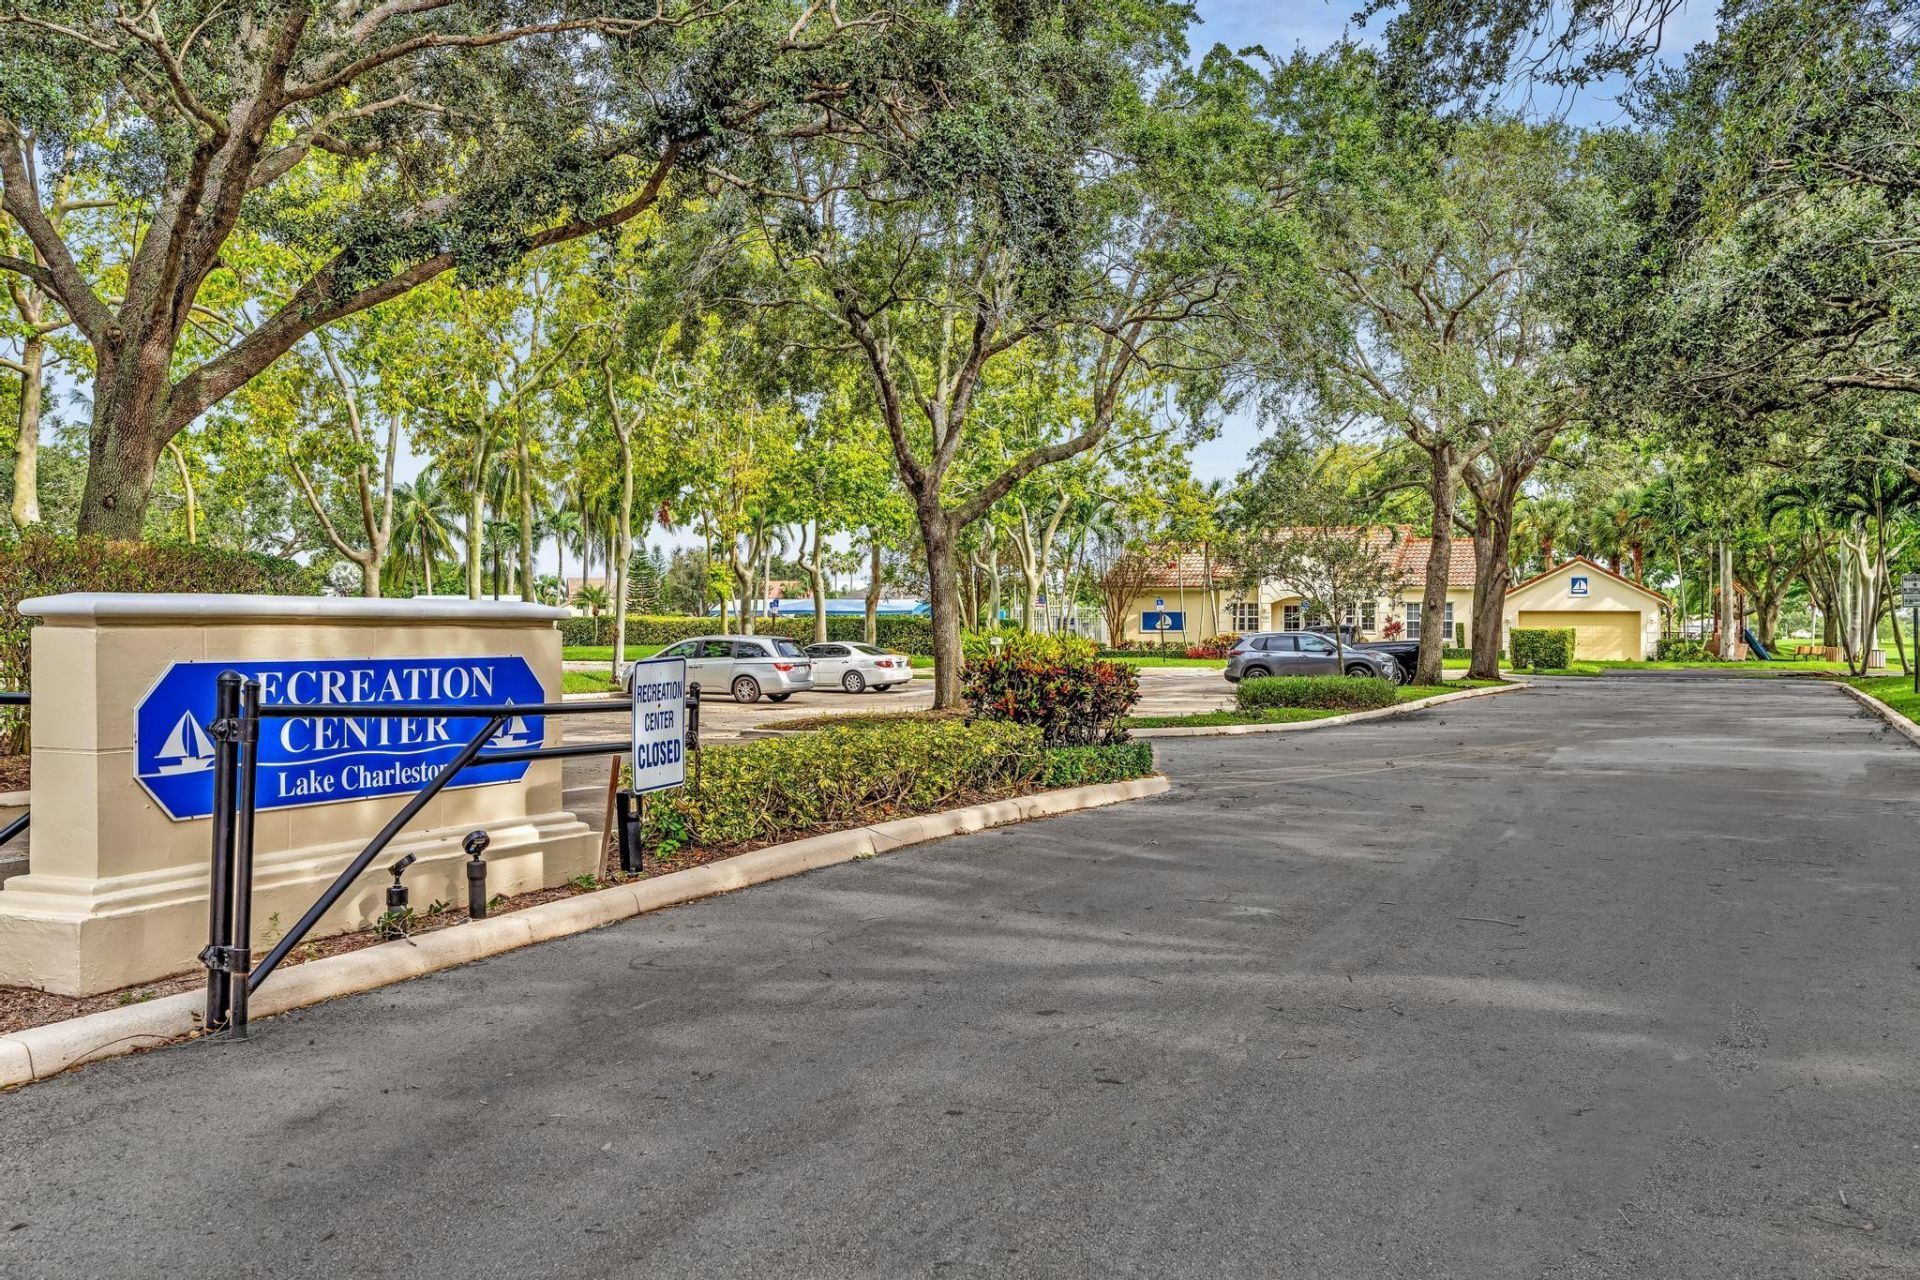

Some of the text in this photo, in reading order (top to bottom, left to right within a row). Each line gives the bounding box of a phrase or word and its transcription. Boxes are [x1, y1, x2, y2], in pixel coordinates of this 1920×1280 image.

[636, 680, 682, 703] RECREATION
[280, 716, 450, 753] CENTER
[644, 710, 674, 732] CENTER
[638, 739, 681, 769] CLOSED
[277, 769, 335, 797] Lake
